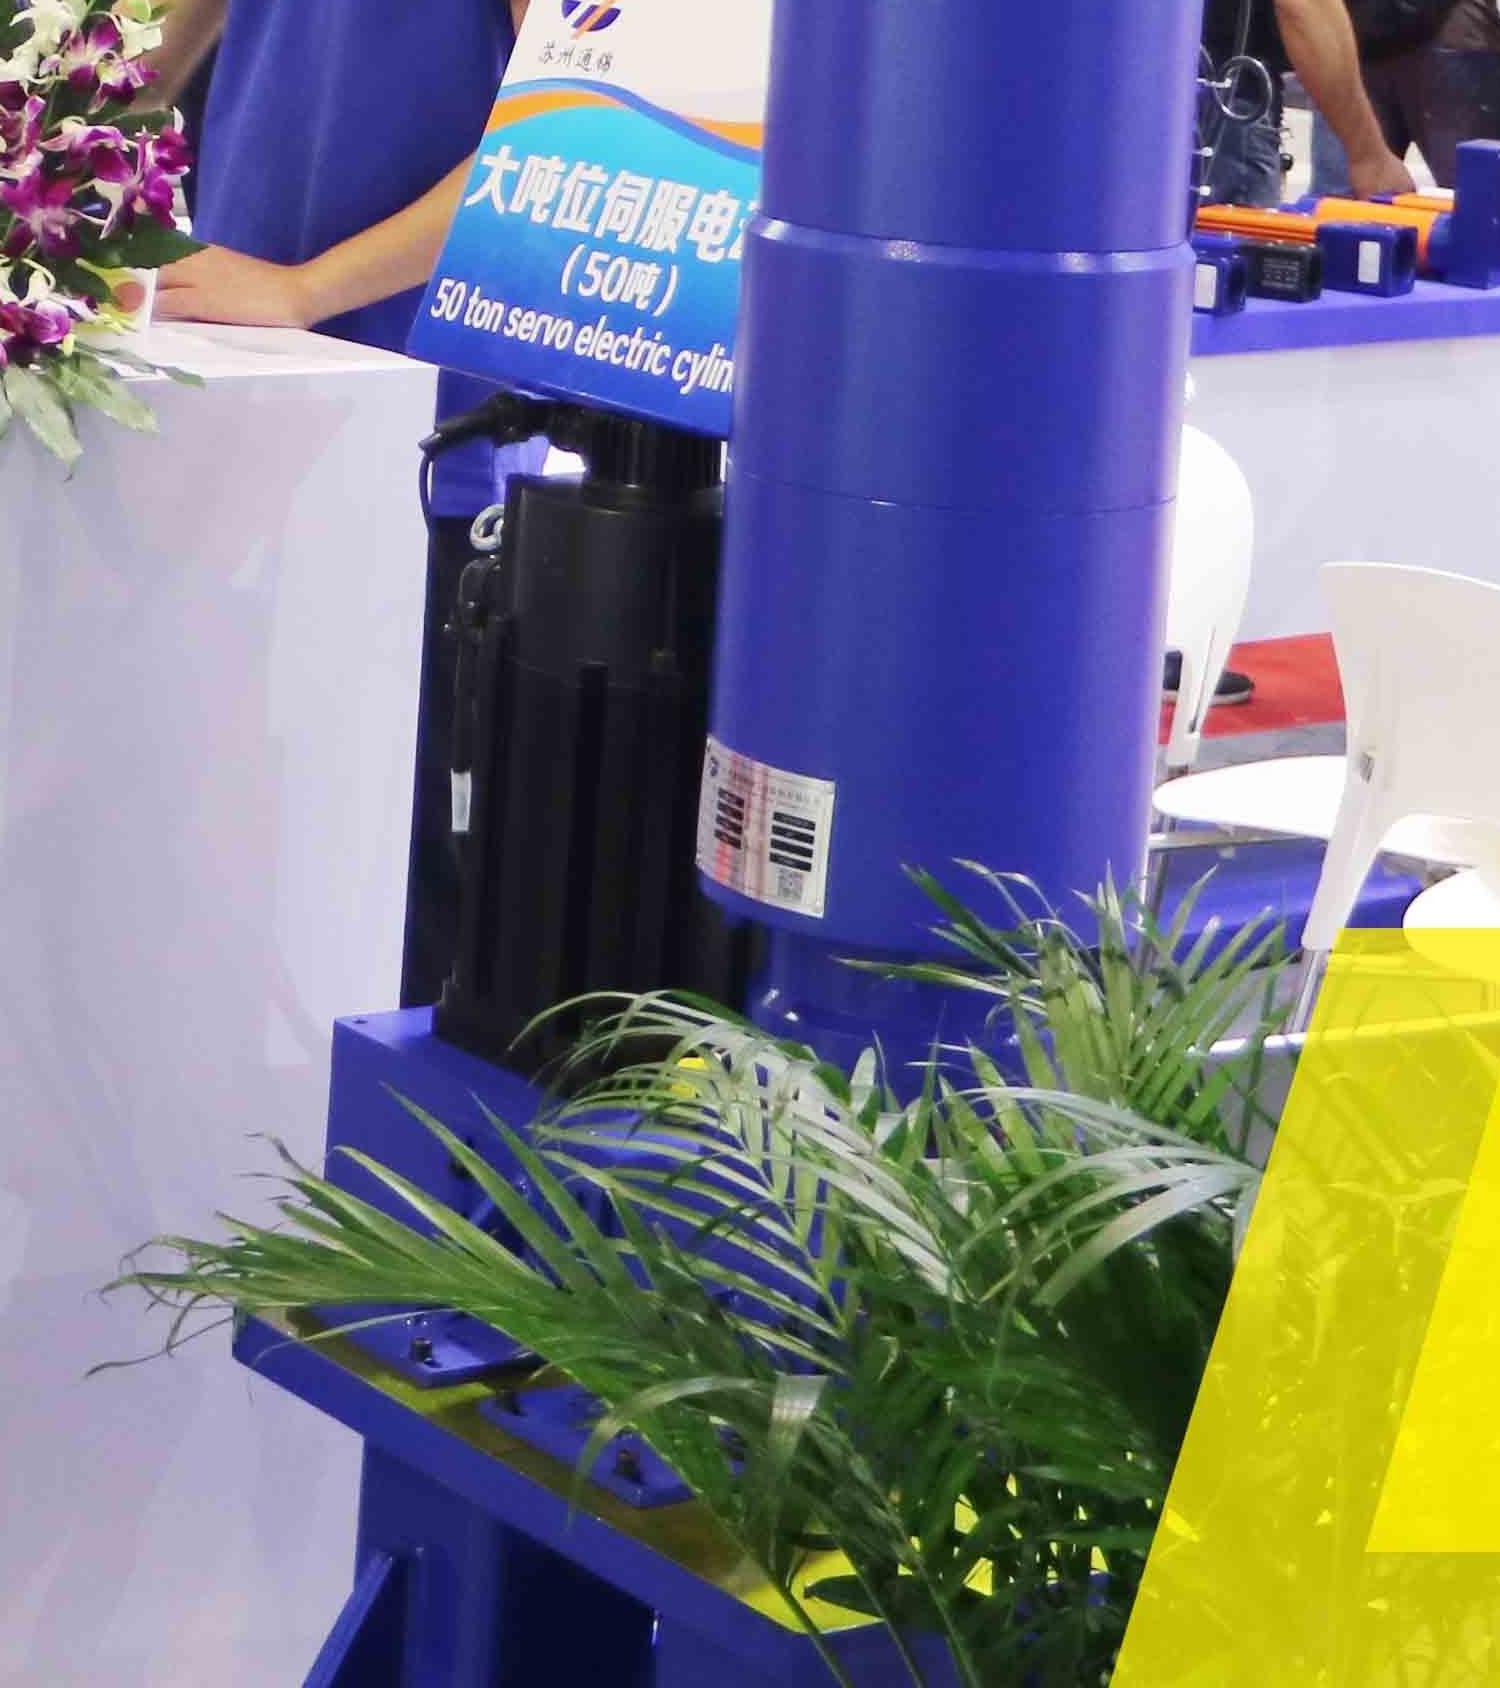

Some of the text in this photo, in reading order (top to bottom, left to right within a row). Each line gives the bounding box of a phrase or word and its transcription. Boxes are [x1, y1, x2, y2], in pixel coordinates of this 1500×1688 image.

[464, 145, 760, 264] 大吨位伺服电
[430, 278, 467, 322] 50
[464, 285, 508, 334] ton
[503, 308, 573, 350] servo
[574, 315, 671, 377] electric
